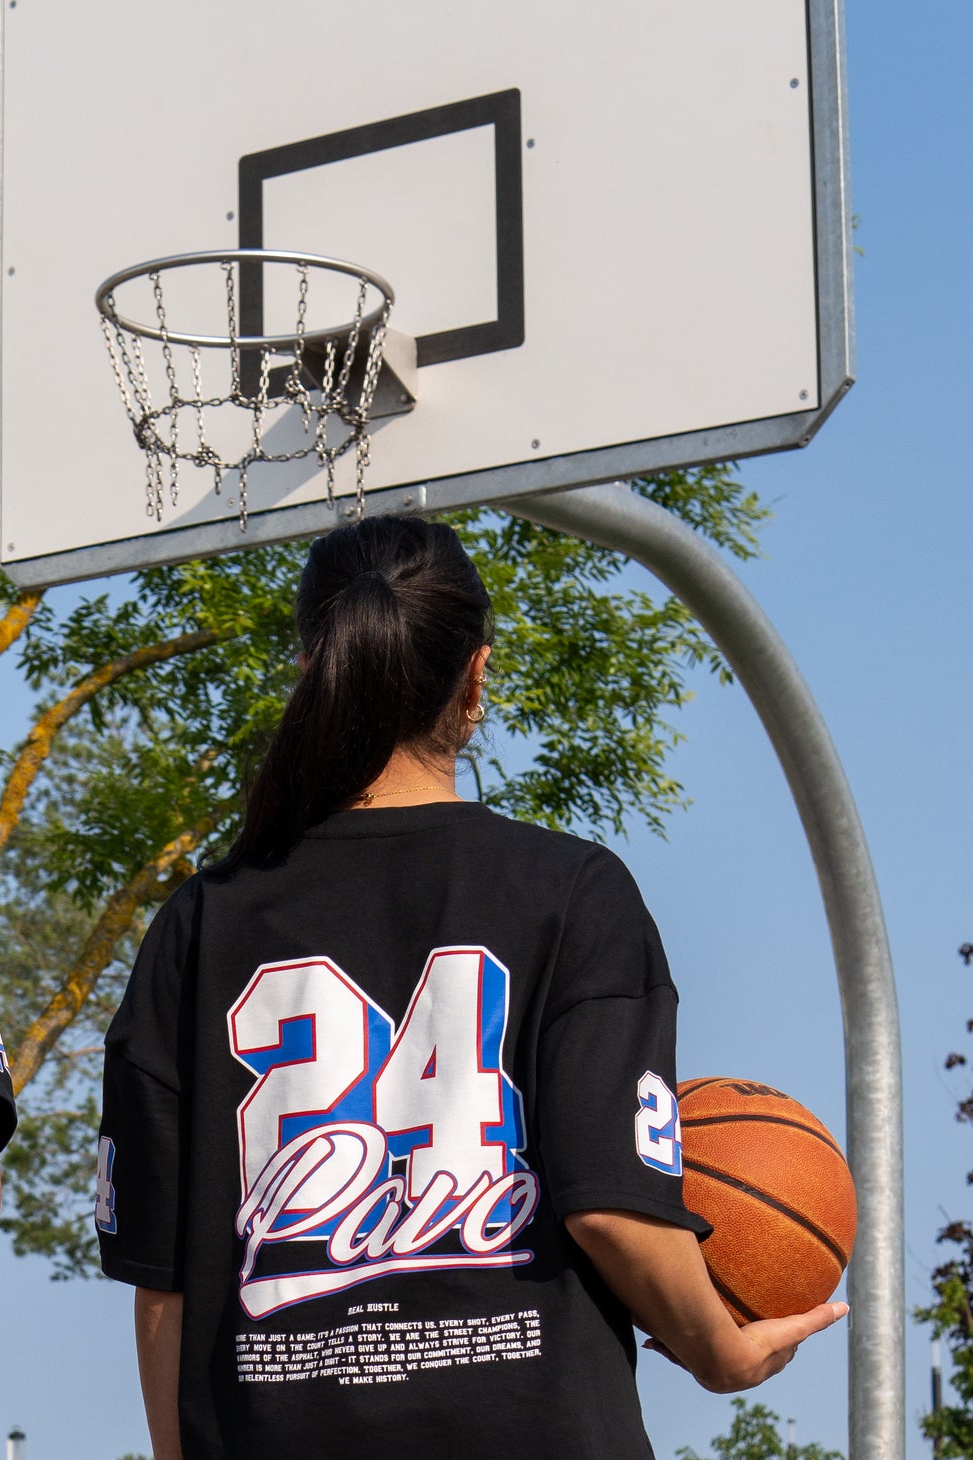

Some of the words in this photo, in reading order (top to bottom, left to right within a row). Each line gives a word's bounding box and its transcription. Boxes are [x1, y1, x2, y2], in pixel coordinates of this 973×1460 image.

[227, 946, 533, 1240] 24
[634, 1070, 682, 1177] 2
[236, 1121, 540, 1284] Pavo
[361, 1323, 382, 1331] THAT
[385, 1322, 422, 1330] CONNECTS
[425, 1321, 436, 1329] US.
[439, 1320, 464, 1328] EVERY
[491, 1313, 515, 1324] EVERY
[367, 1303, 399, 1312] HUSTLE
[253, 1344, 272, 1352] MOVE
[307, 1341, 325, 1350] COURT
[328, 1336, 345, 1346] TELLS
[348, 1335, 353, 1343] A
[389, 1333, 401, 1341] WE
[405, 1332, 420, 1340] ARE
[424, 1331, 439, 1339] THE
[443, 1328, 473, 1337] STREET
[525, 1320, 540, 1328] THE
[263, 1354, 272, 1362] OF
[275, 1354, 289, 1362] THE
[334, 1345, 355, 1354] NEVER
[358, 1344, 375, 1352] GIVE
[377, 1344, 387, 1352] UP
[390, 1343, 405, 1351] AND
[408, 1340, 440, 1350] ALWAYS
[442, 1338, 469, 1347] STRIVE
[472, 1336, 487, 1344] FOR
[526, 1329, 541, 1338] OUR
[237, 1364, 254, 1372] BER
[265, 1364, 282, 1372] MORE
[285, 1363, 302, 1371] THAN
[303, 1361, 318, 1370] JUST
[348, 1355, 356, 1363] IT
[359, 1355, 389, 1363] STANDS
[391, 1354, 405, 1362] FOR
[407, 1352, 422, 1360] OUR
[476, 1345, 490, 1353] OUR
[526, 1339, 541, 1348] AND
[245, 1374, 284, 1382] RELENTLESS
[286, 1372, 310, 1381] PURSUIT
[311, 1370, 318, 1378] OF
[406, 1362, 418, 1370] WE
[421, 1359, 452, 1369] CONQUER
[454, 1357, 470, 1365] THE
[339, 1377, 350, 1385] WE
[352, 1376, 374, 1384] MAKE
[376, 1373, 409, 1383] HISTORY.
